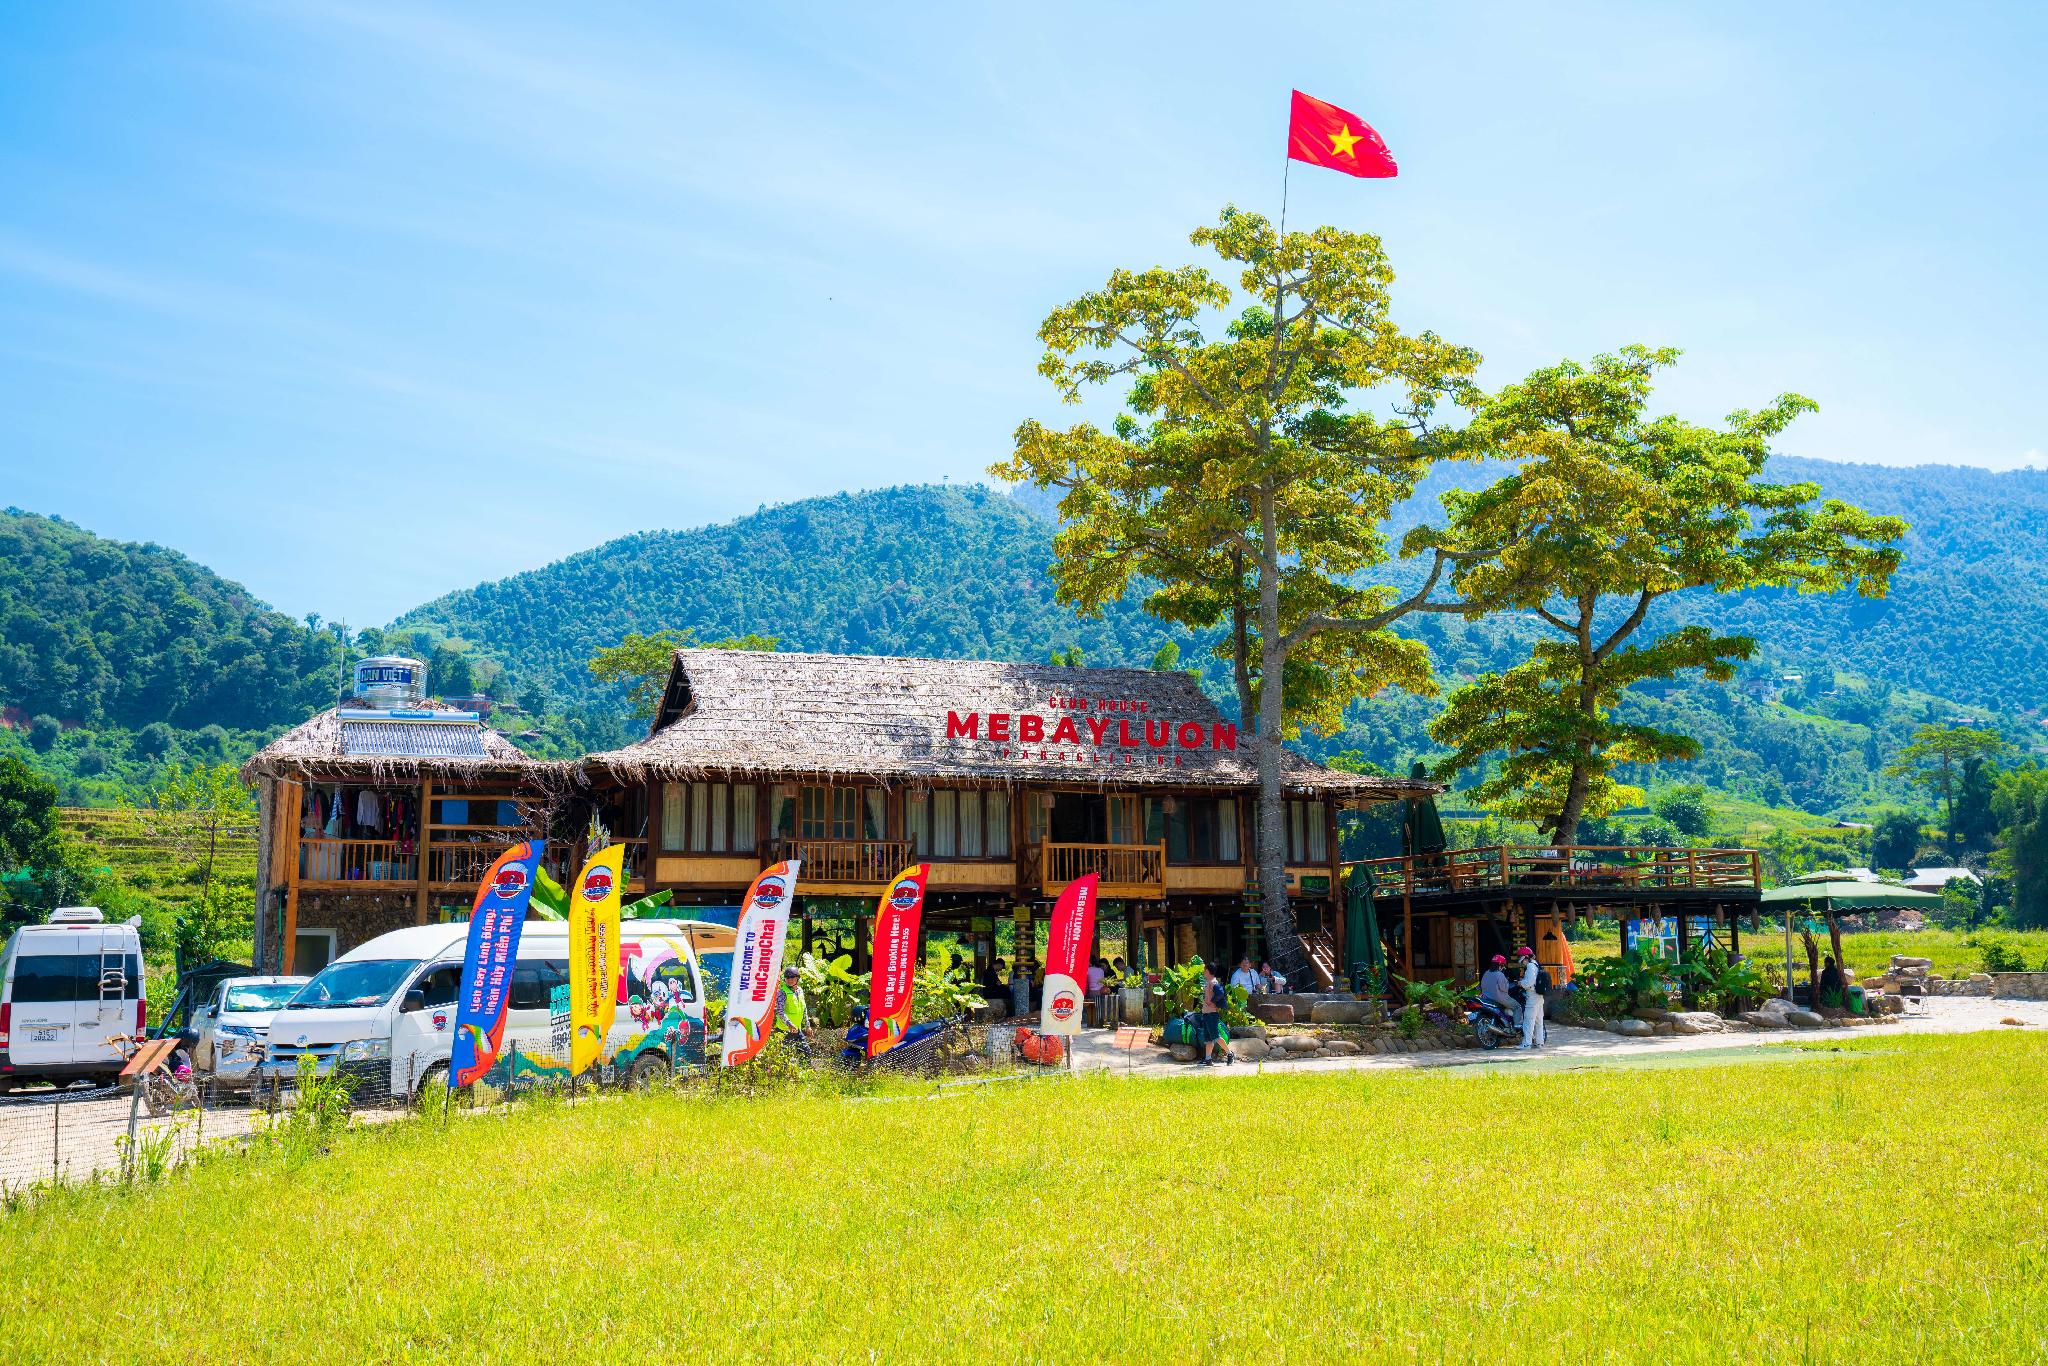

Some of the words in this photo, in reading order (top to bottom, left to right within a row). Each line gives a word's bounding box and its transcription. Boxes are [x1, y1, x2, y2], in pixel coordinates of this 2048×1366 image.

[1049, 697, 1087, 710] CLUB
[1098, 699, 1150, 713] HOUSE
[946, 710, 1237, 751] MEBAYLUON
[1003, 749, 1182, 766] PARAGLIDNG
[890, 914, 901, 937] Here!
[1072, 886, 1088, 941] MEBAYLUON
[745, 931, 756, 943] TO
[739, 945, 755, 991] WELCOME
[751, 919, 776, 1002] MuCangChai
[887, 938, 900, 972] Booking
[473, 967, 488, 987] Bay
